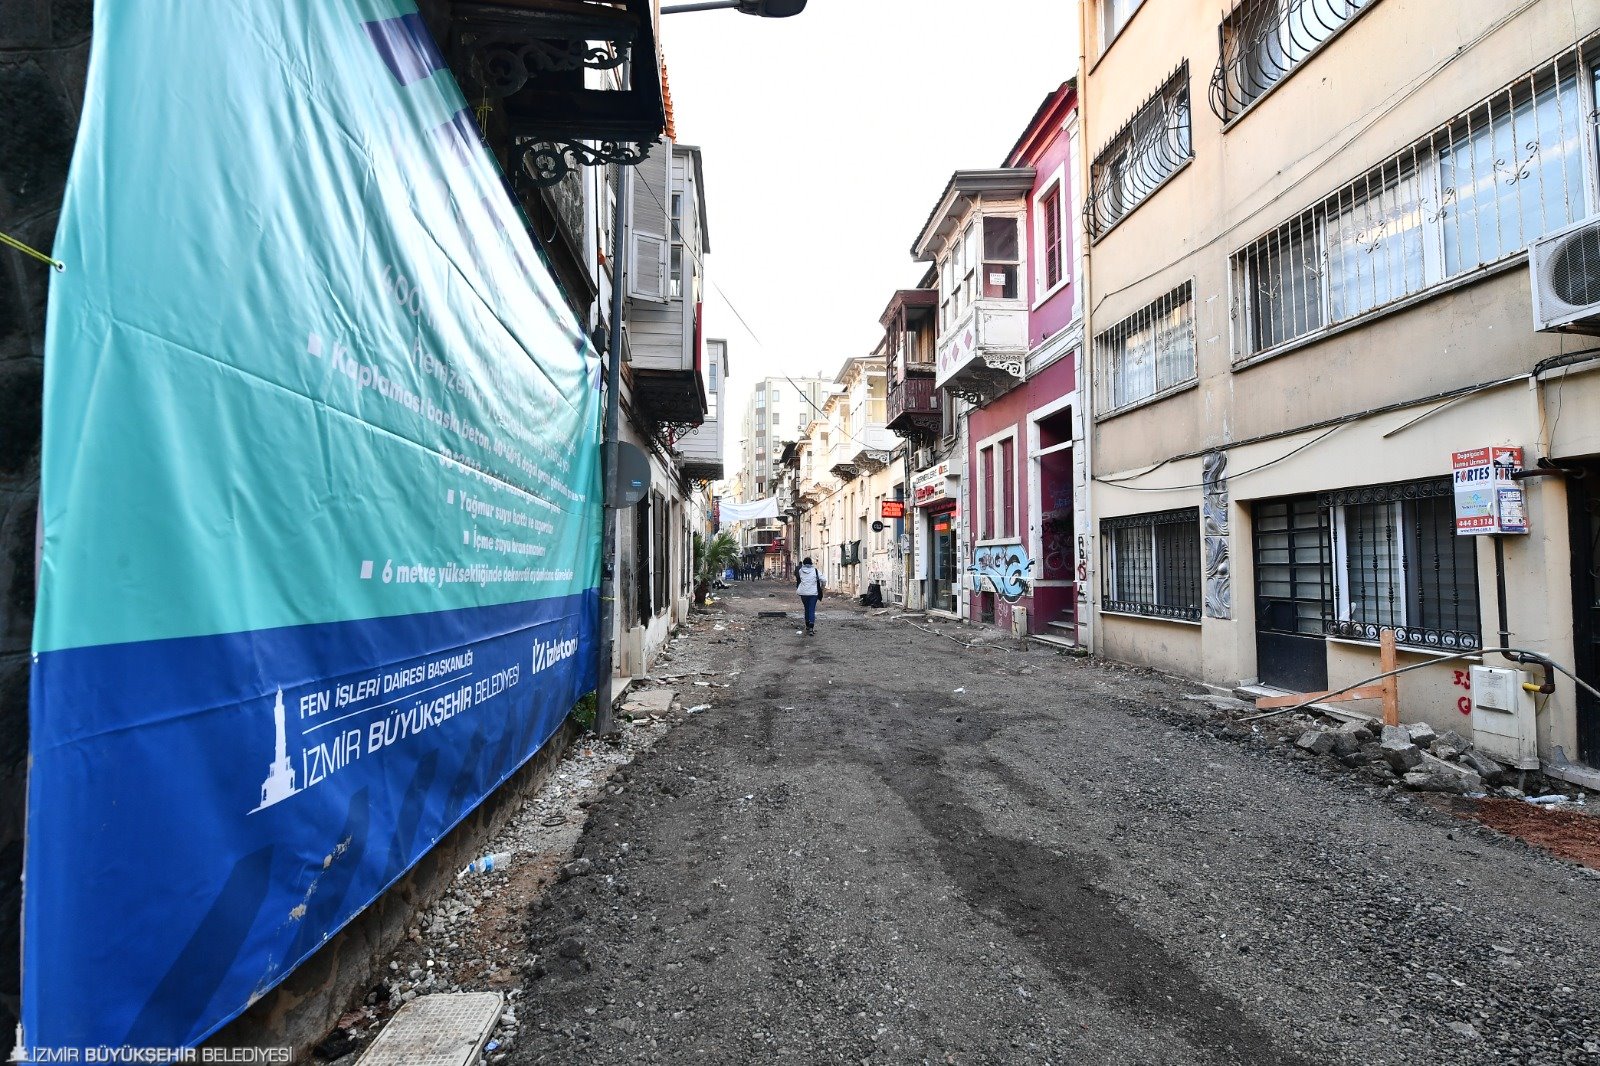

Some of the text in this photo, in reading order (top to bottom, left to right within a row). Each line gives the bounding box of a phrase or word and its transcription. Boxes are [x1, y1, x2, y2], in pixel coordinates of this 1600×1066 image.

[1455, 466, 1490, 484] FORTES
[1458, 519, 1471, 527] 444
[1480, 518, 1493, 526] 118
[381, 558, 394, 584] 6
[396, 563, 436, 583] metre
[300, 691, 331, 720] FEN
[335, 674, 382, 708] İŞLERİ
[383, 663, 426, 694] DAİRESİ
[302, 662, 520, 790] İZMİR BÜYÜKŞEHİR BELEDİYESİ
